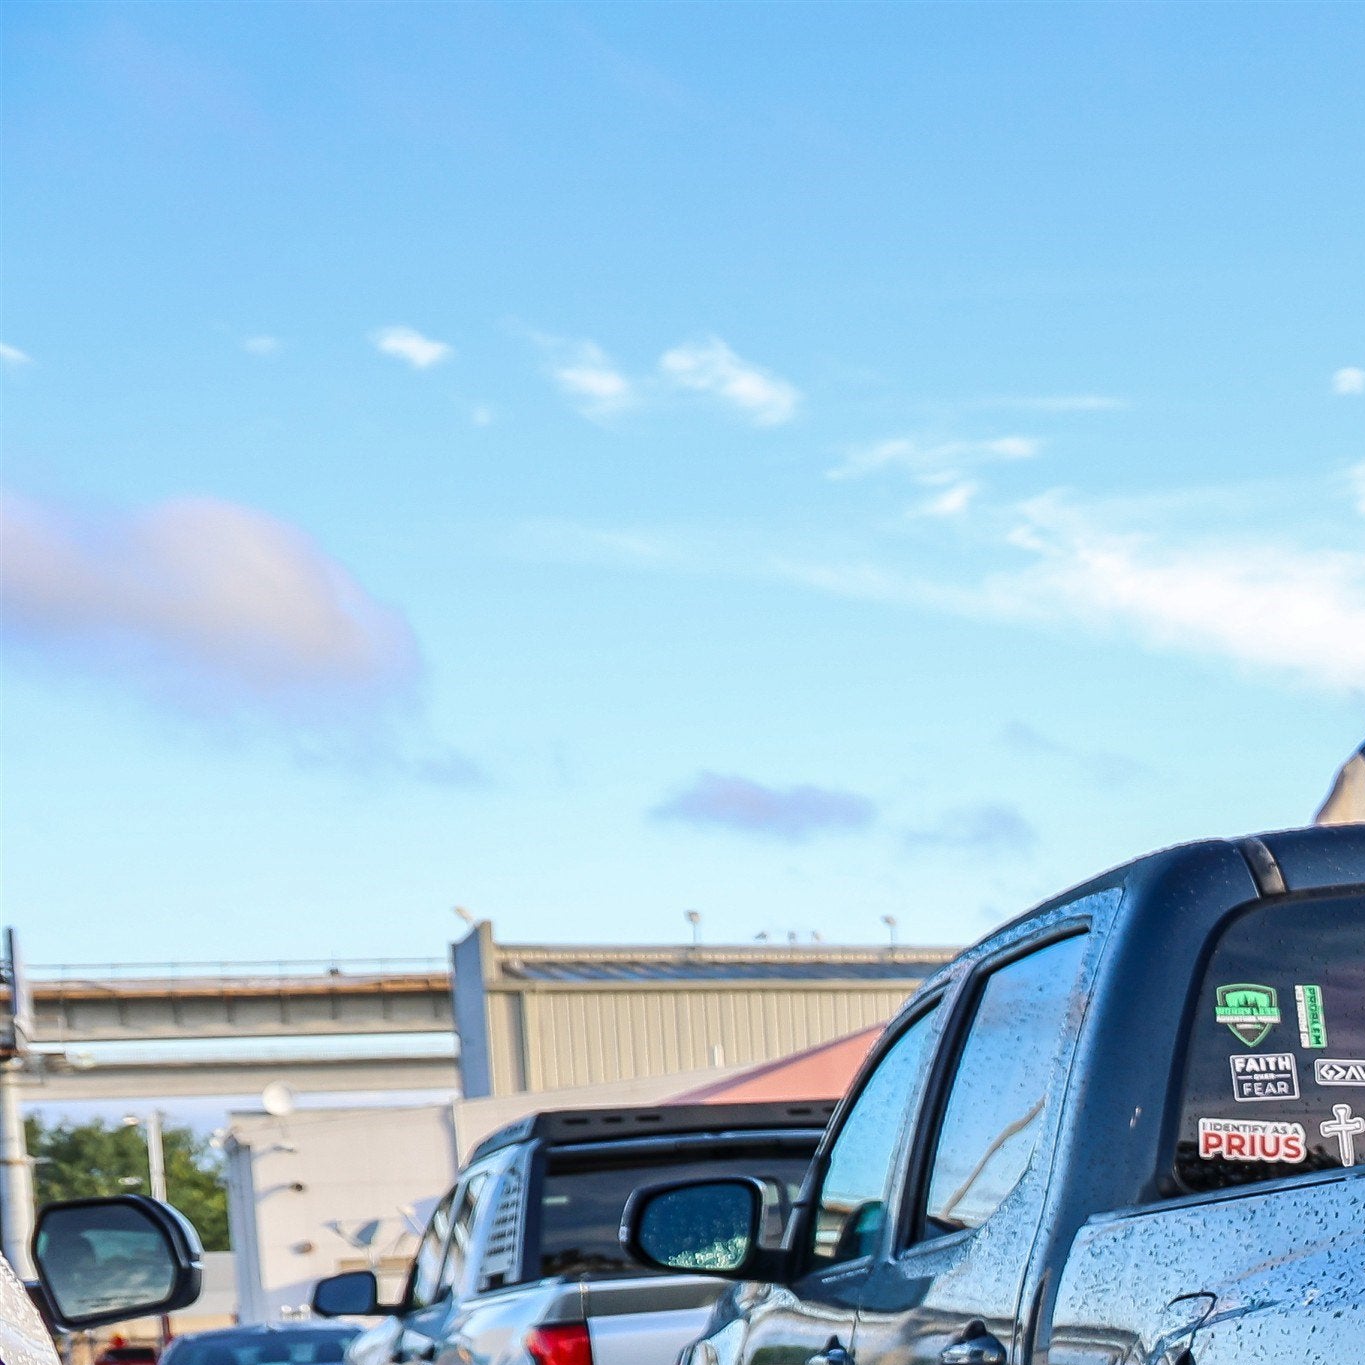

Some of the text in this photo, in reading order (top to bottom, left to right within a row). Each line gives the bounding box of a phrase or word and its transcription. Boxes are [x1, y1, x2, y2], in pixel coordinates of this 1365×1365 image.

[1234, 1055, 1292, 1073] FAITH
[1243, 1081, 1290, 1096] FEAR
[1209, 1122, 1268, 1133] IDENTIFY
[1271, 1125, 1287, 1135] AS
[1291, 1126, 1300, 1135] A
[1203, 1131, 1301, 1159] PRIUS
